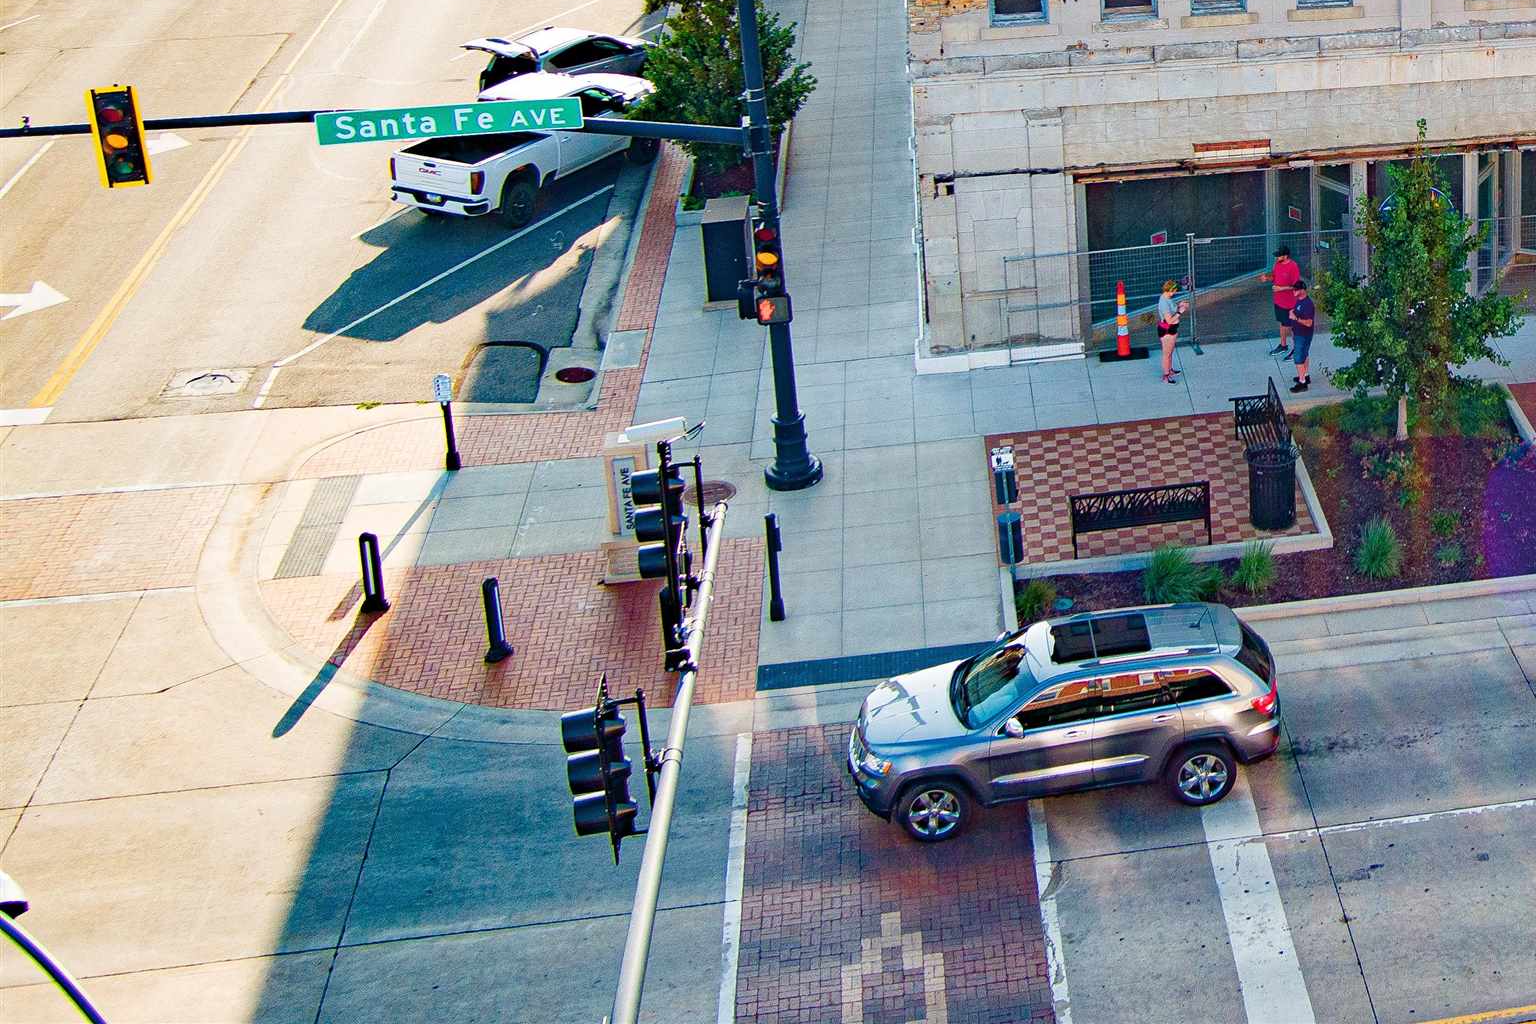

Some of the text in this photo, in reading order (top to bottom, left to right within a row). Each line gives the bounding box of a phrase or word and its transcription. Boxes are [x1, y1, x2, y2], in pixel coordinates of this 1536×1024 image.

[335, 107, 567, 140] Santa Fe AVE
[418, 167, 442, 177] GMC
[620, 467, 635, 529] SANTA FE AVE
